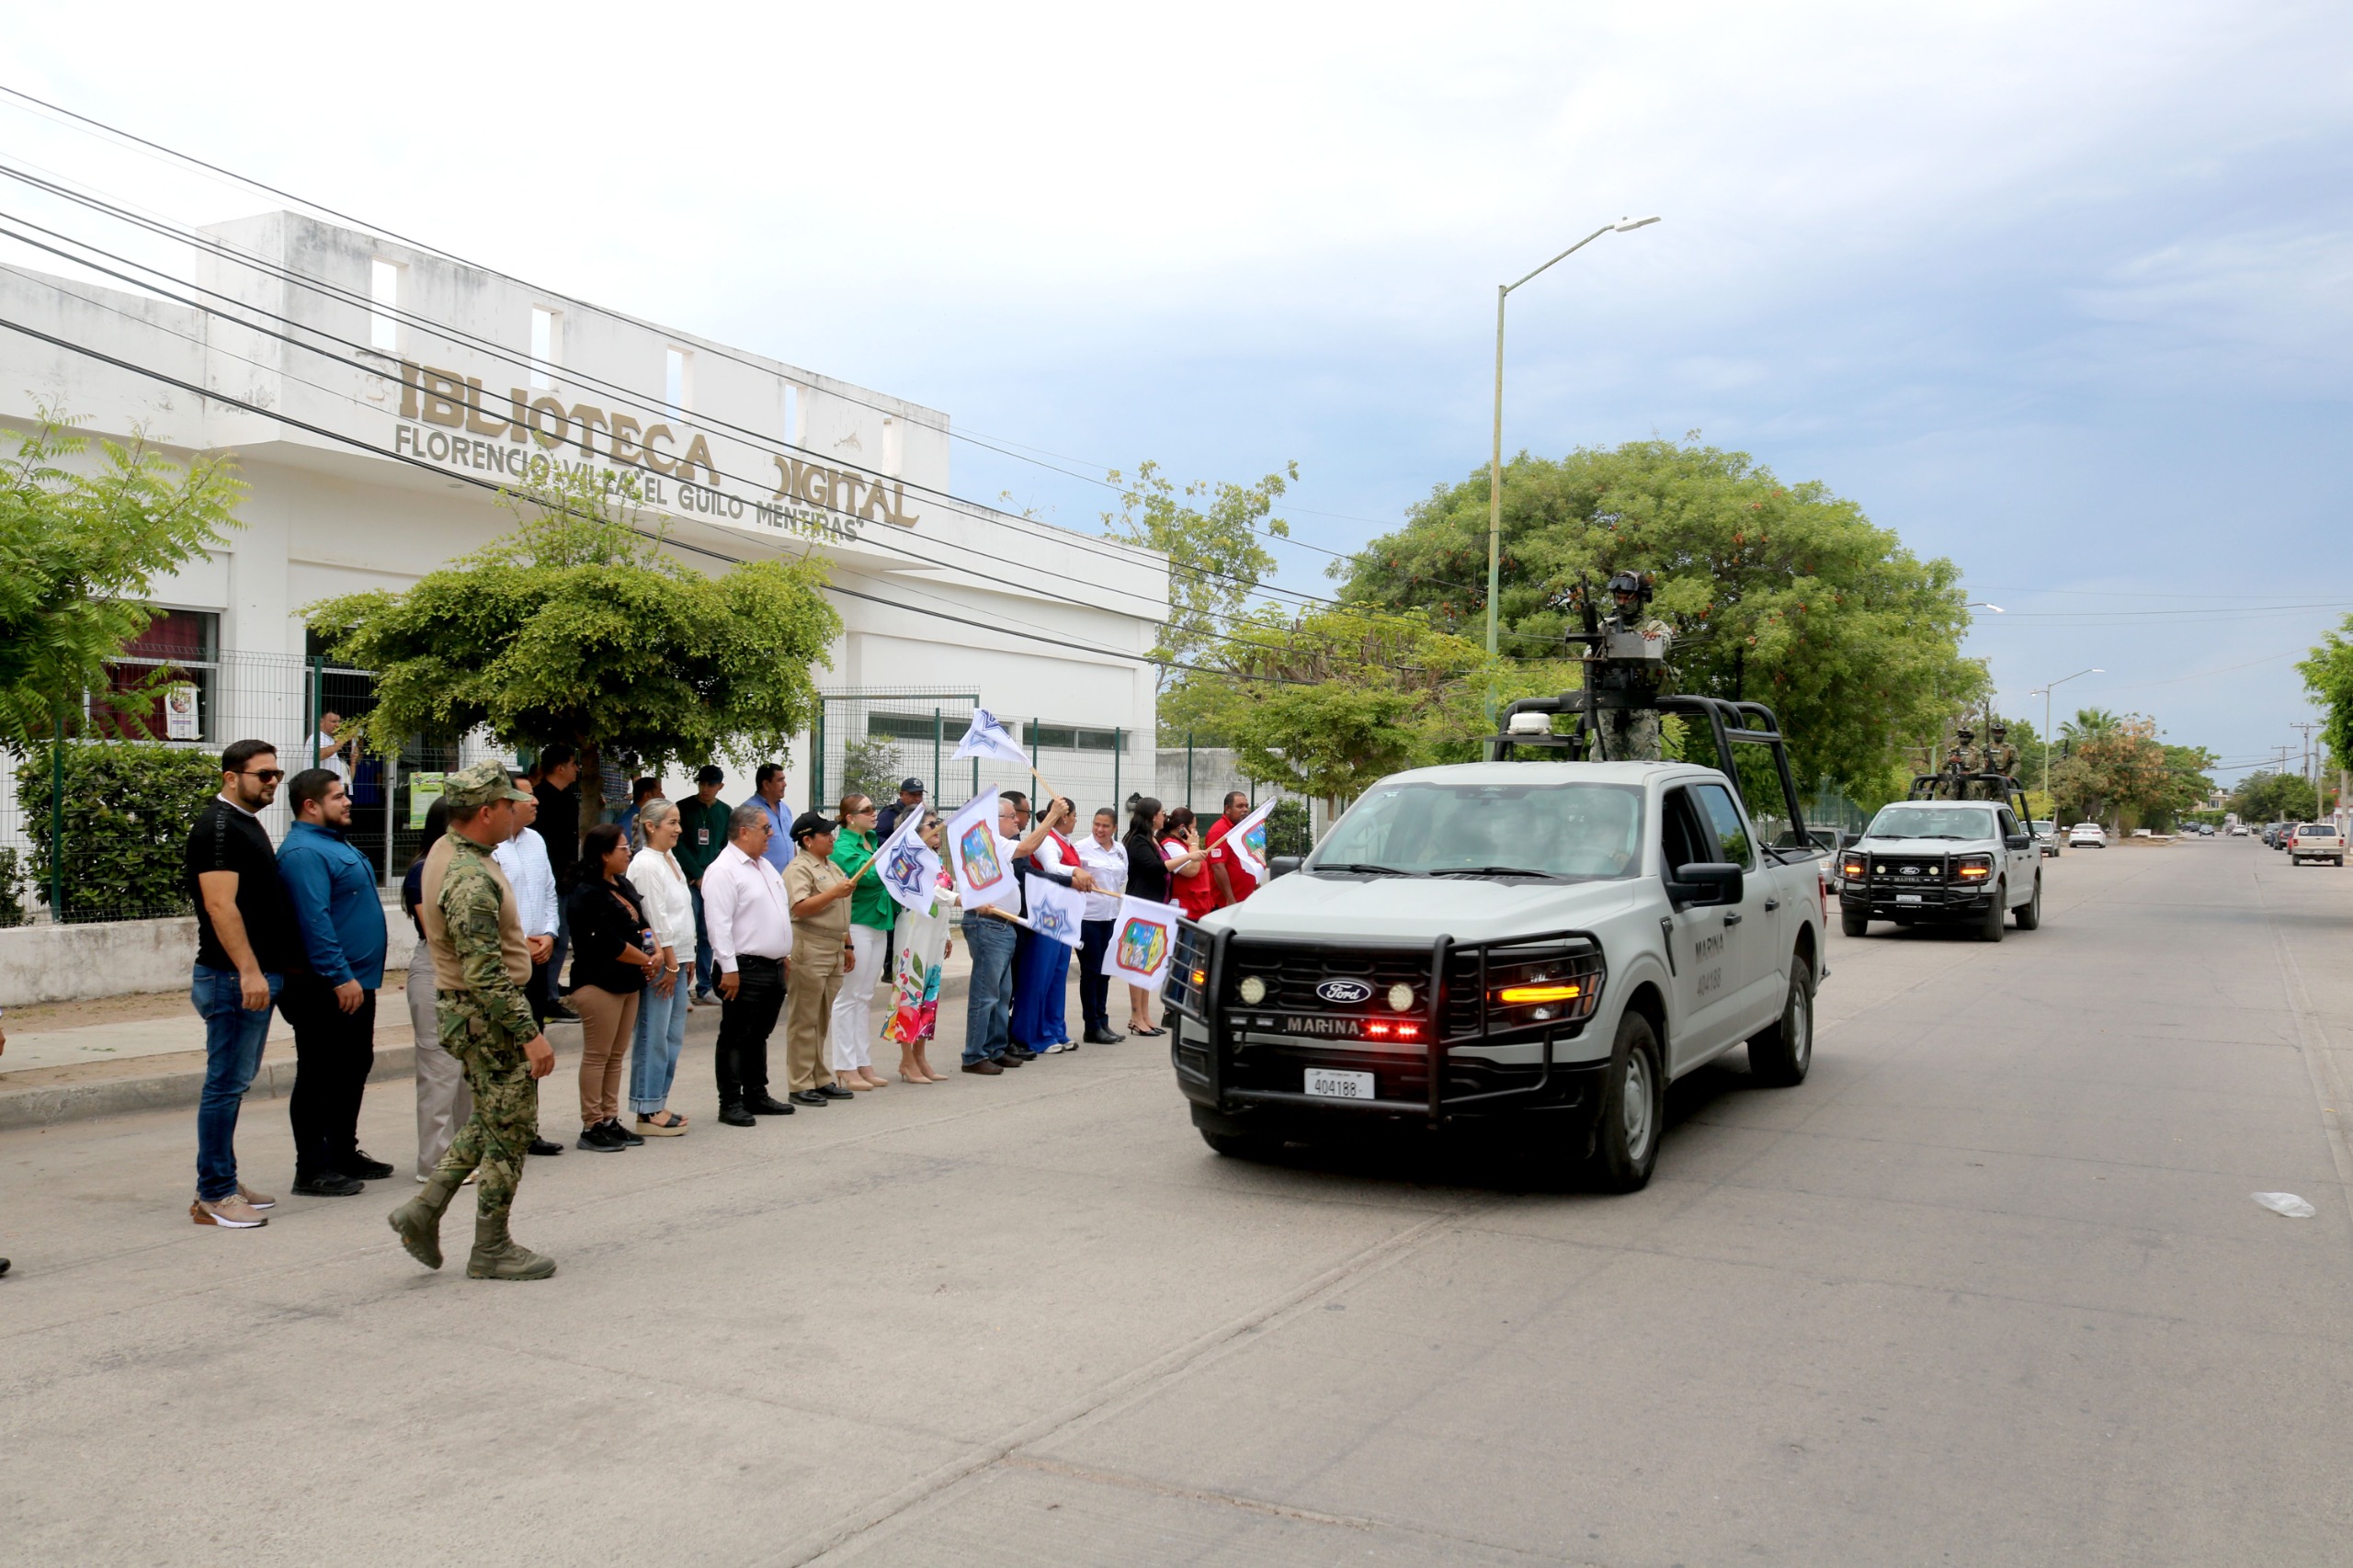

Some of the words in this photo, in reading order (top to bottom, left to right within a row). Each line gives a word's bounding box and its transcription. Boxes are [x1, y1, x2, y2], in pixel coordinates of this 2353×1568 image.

[398, 358, 722, 486] IBLIOTECA
[395, 424, 550, 480] FLORENCIO
[677, 483, 745, 519] GÜILO
[1326, 983, 1360, 1001] Ford
[1287, 1017, 1359, 1035] MARINA
[1313, 1078, 1358, 1097] 404188
